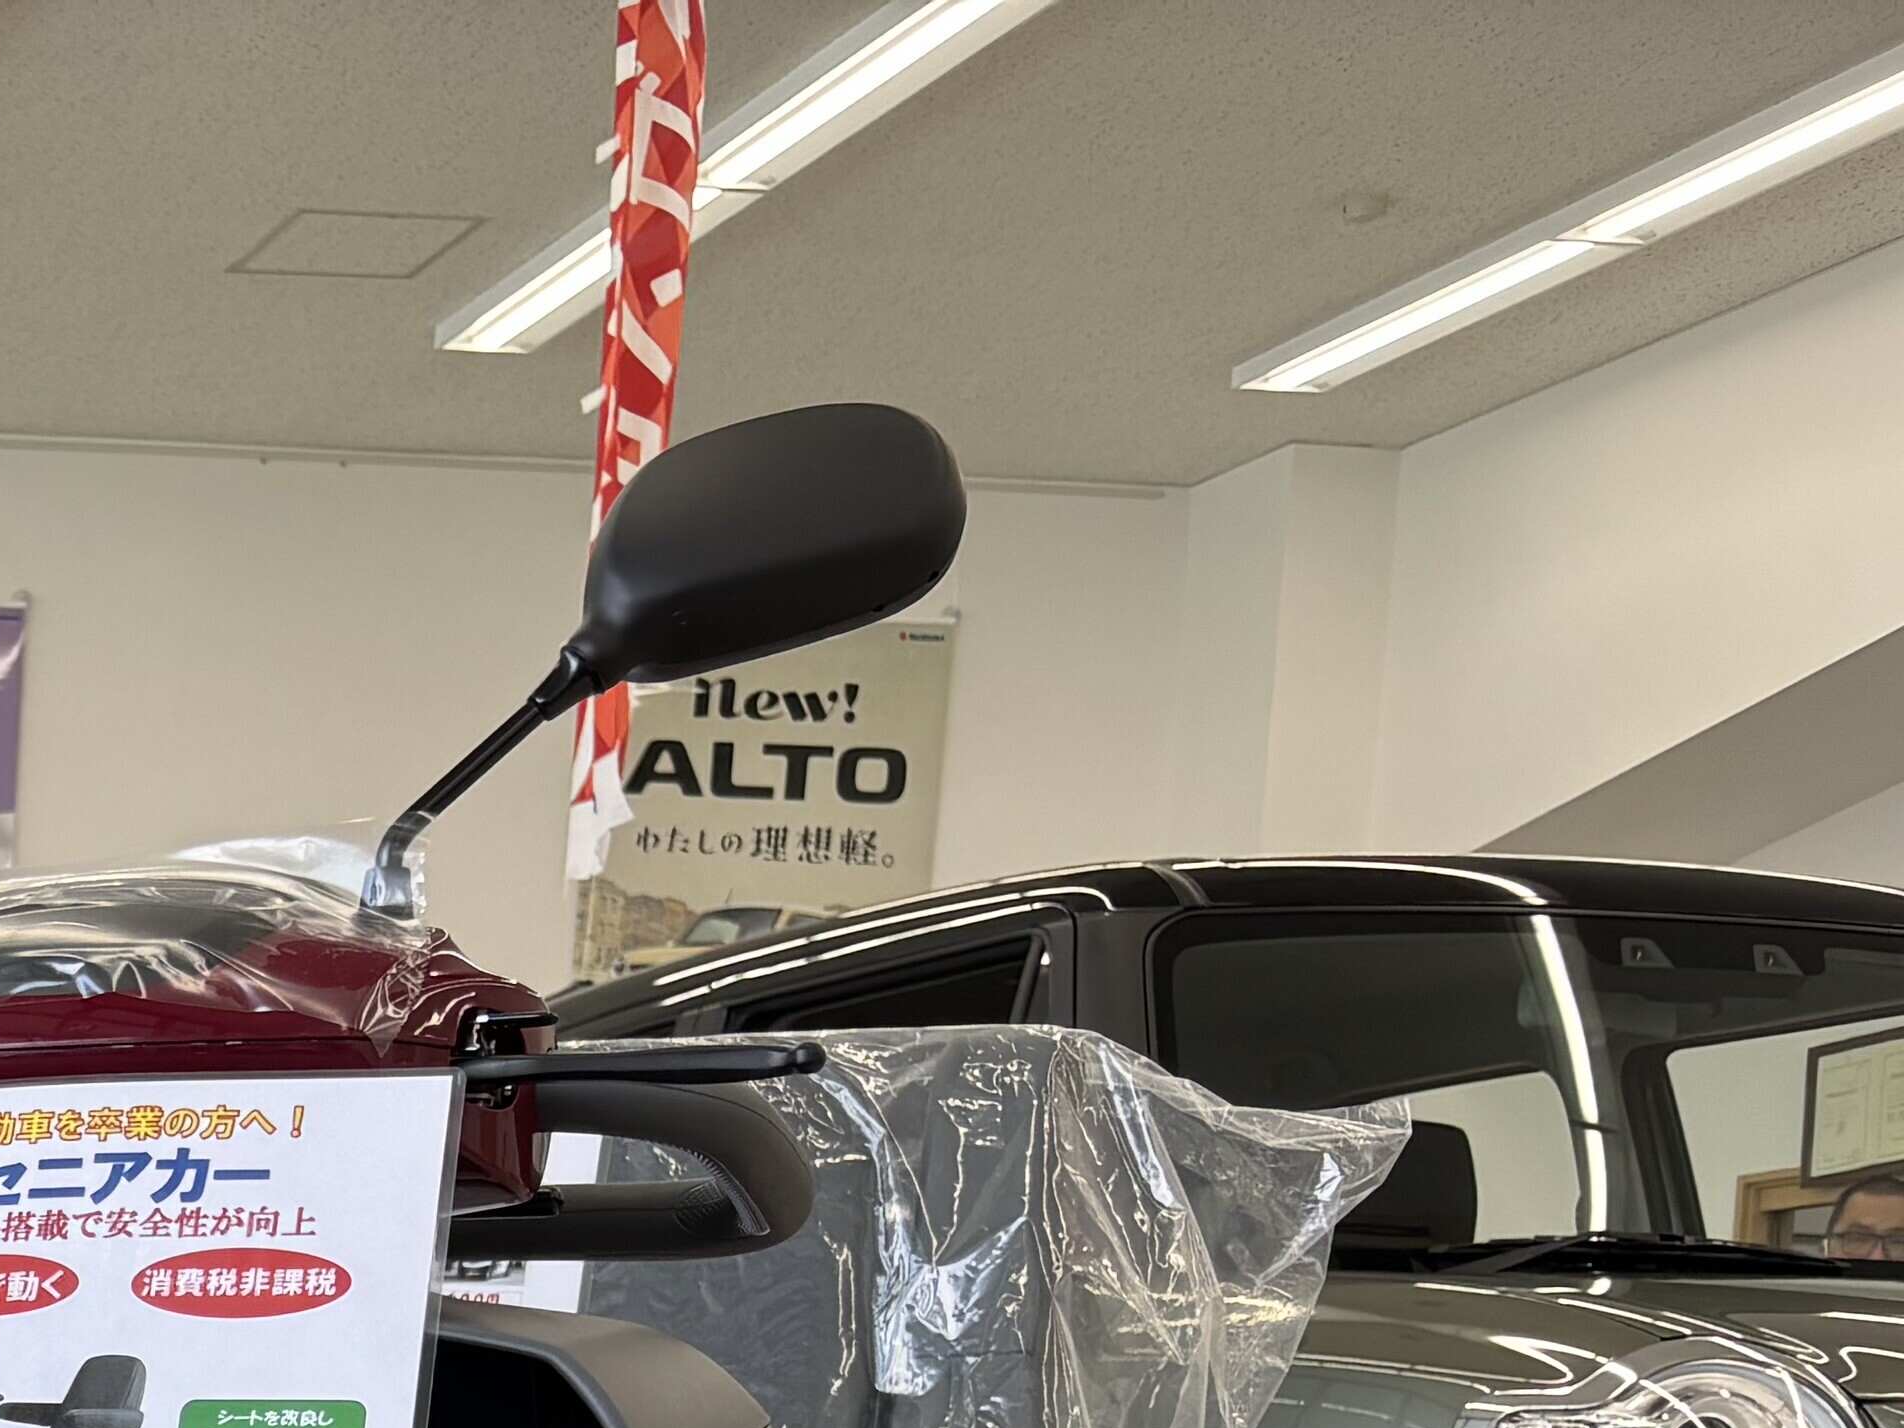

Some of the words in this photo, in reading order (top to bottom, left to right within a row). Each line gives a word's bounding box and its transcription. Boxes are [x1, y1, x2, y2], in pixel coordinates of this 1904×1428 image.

[622, 740, 908, 804] ALTO
[636, 825, 895, 868] わたしの理想軽。
[140, 1267, 337, 1298] 消費税非課税
[218, 1407, 334, 1426] シートを改良し
